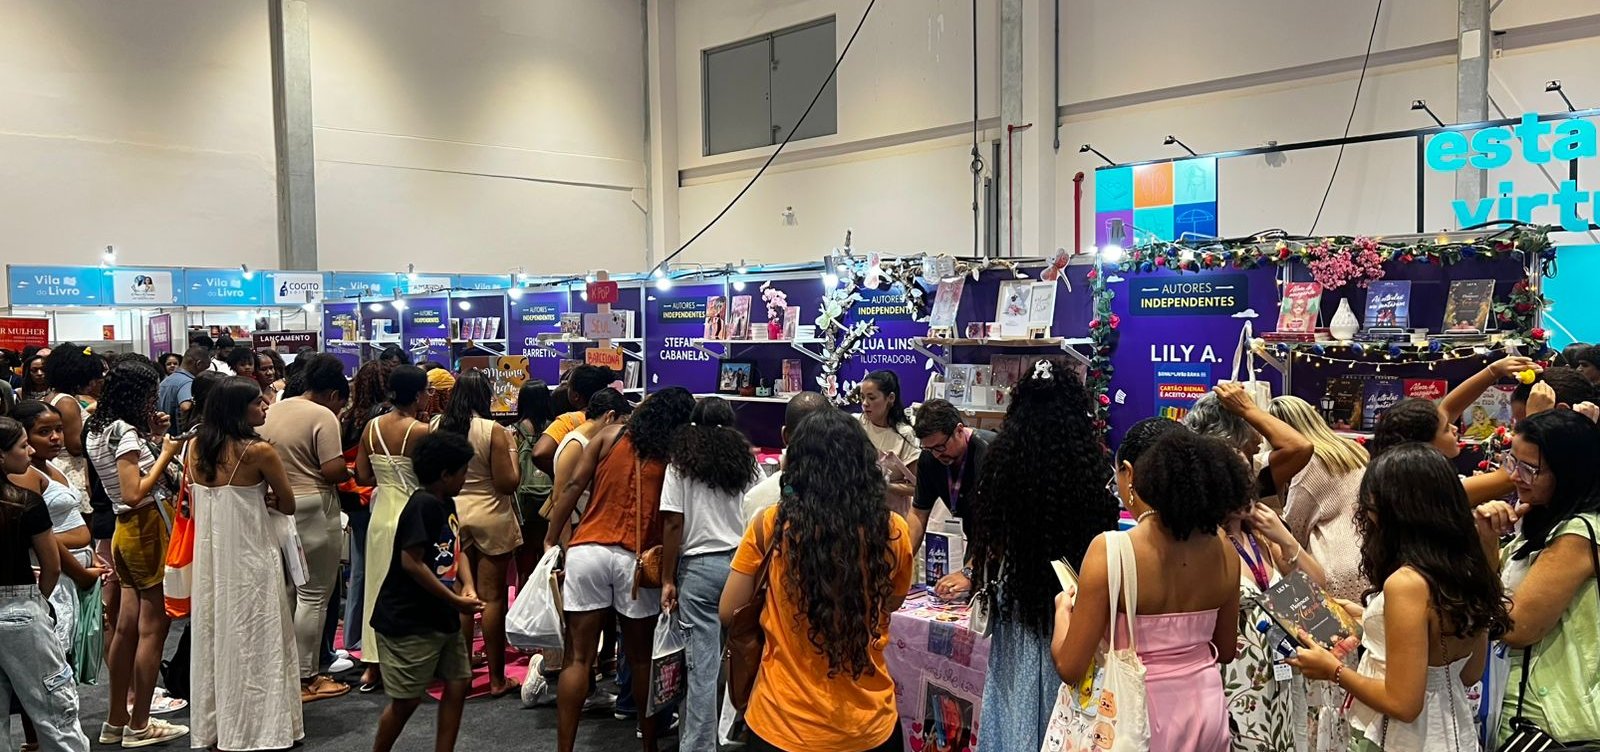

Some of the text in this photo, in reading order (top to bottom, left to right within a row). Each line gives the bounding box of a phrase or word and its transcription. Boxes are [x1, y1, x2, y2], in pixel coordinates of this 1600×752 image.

[1426, 112, 1597, 172] esta
[1451, 181, 1600, 233] virt
[34, 275, 60, 285] Vila
[205, 278, 228, 287] Vila
[48, 286, 80, 296] Livro
[289, 282, 319, 290] COGITO
[1161, 282, 1212, 294] AUTORES
[217, 288, 244, 297] Livro
[1141, 296, 1235, 308] INDEPENDENTES
[260, 335, 311, 343] LANÇAMENTO
[862, 337, 914, 350] LUA LINS
[660, 350, 710, 361] CABANELAS
[1151, 344, 1223, 363] LILY A.
[860, 354, 917, 364] ILUSTRADORA
